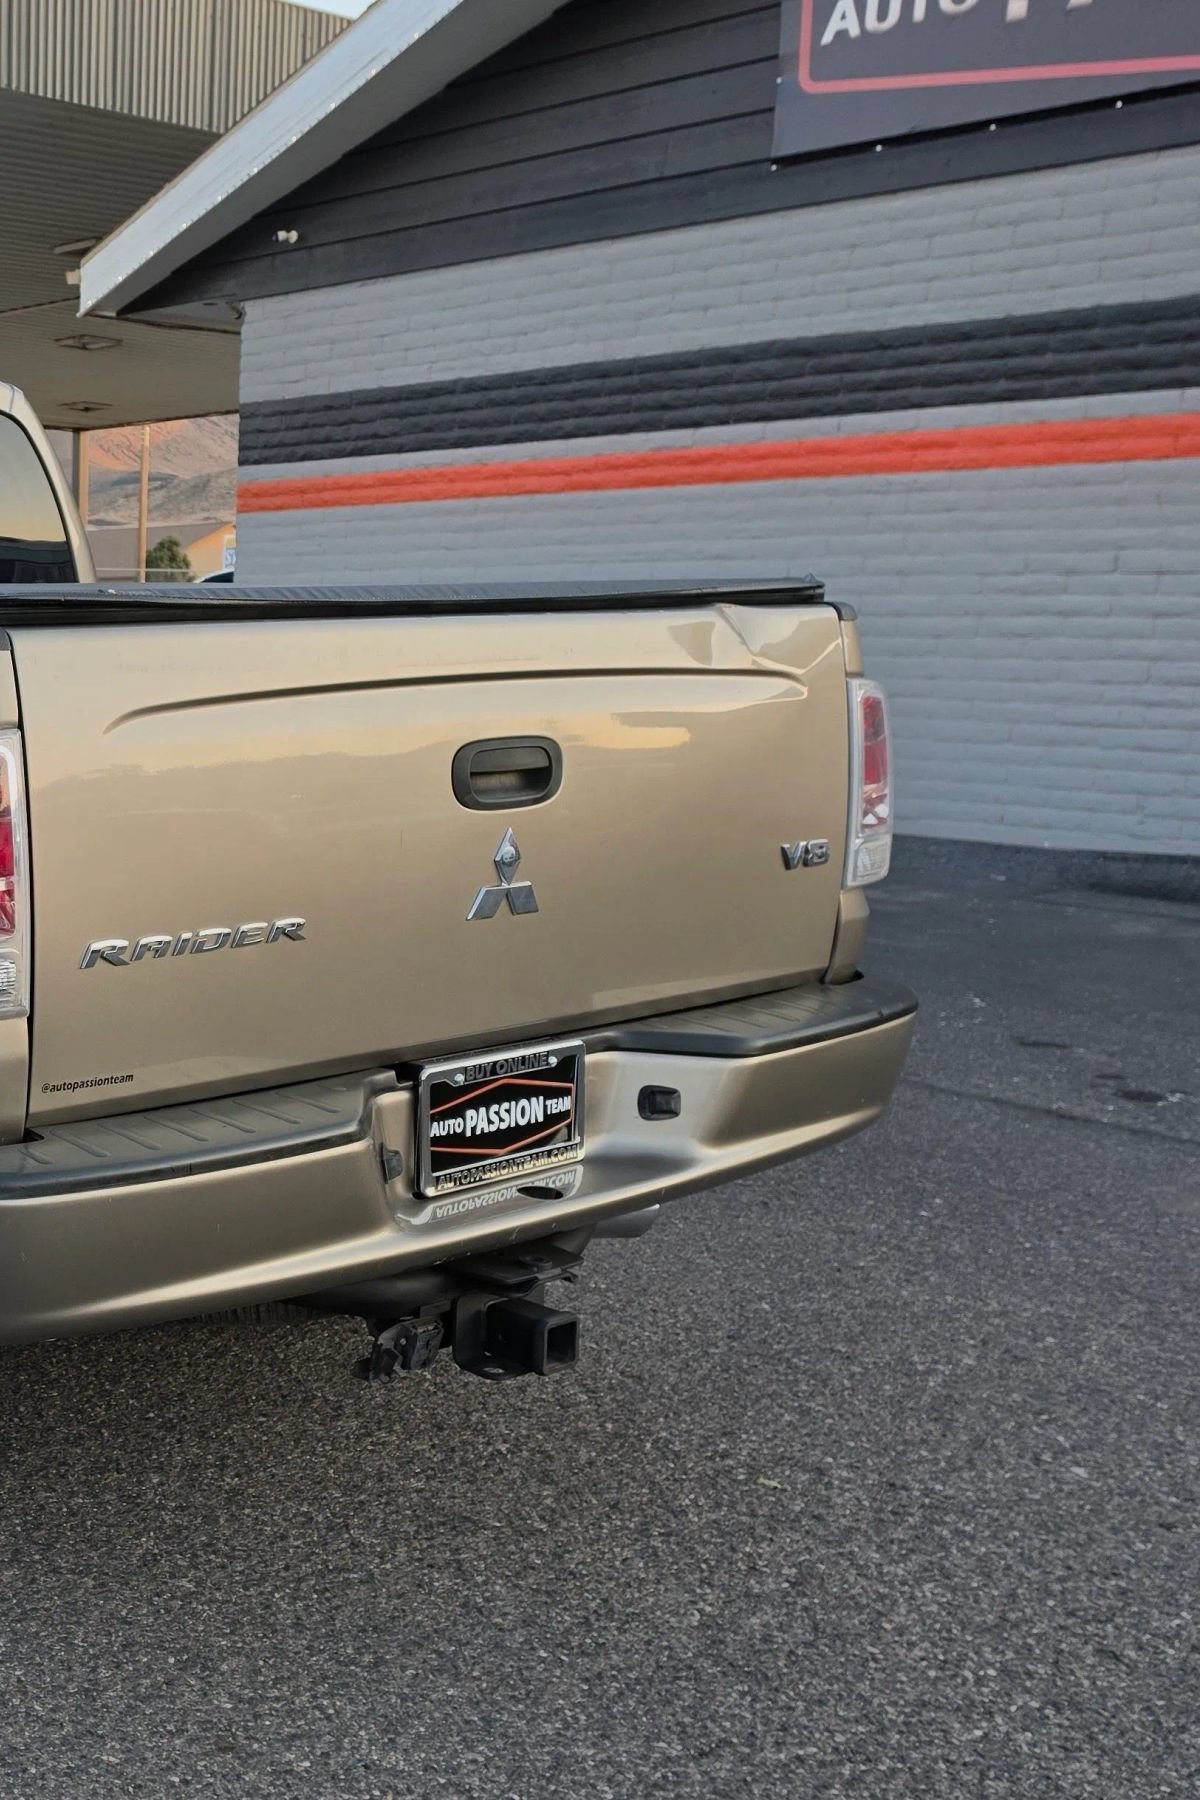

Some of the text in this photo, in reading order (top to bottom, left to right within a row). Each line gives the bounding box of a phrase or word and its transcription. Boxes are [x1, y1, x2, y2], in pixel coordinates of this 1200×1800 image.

[79, 917, 307, 969] RAIDER
[41, 1073, 134, 1093] @autopassionteam
[465, 1051, 549, 1082] BUY ONLINE
[430, 1095, 571, 1138] AUTO PASSION TEAM
[437, 1146, 579, 1191] AUTOPASSIONTEAM.COM
